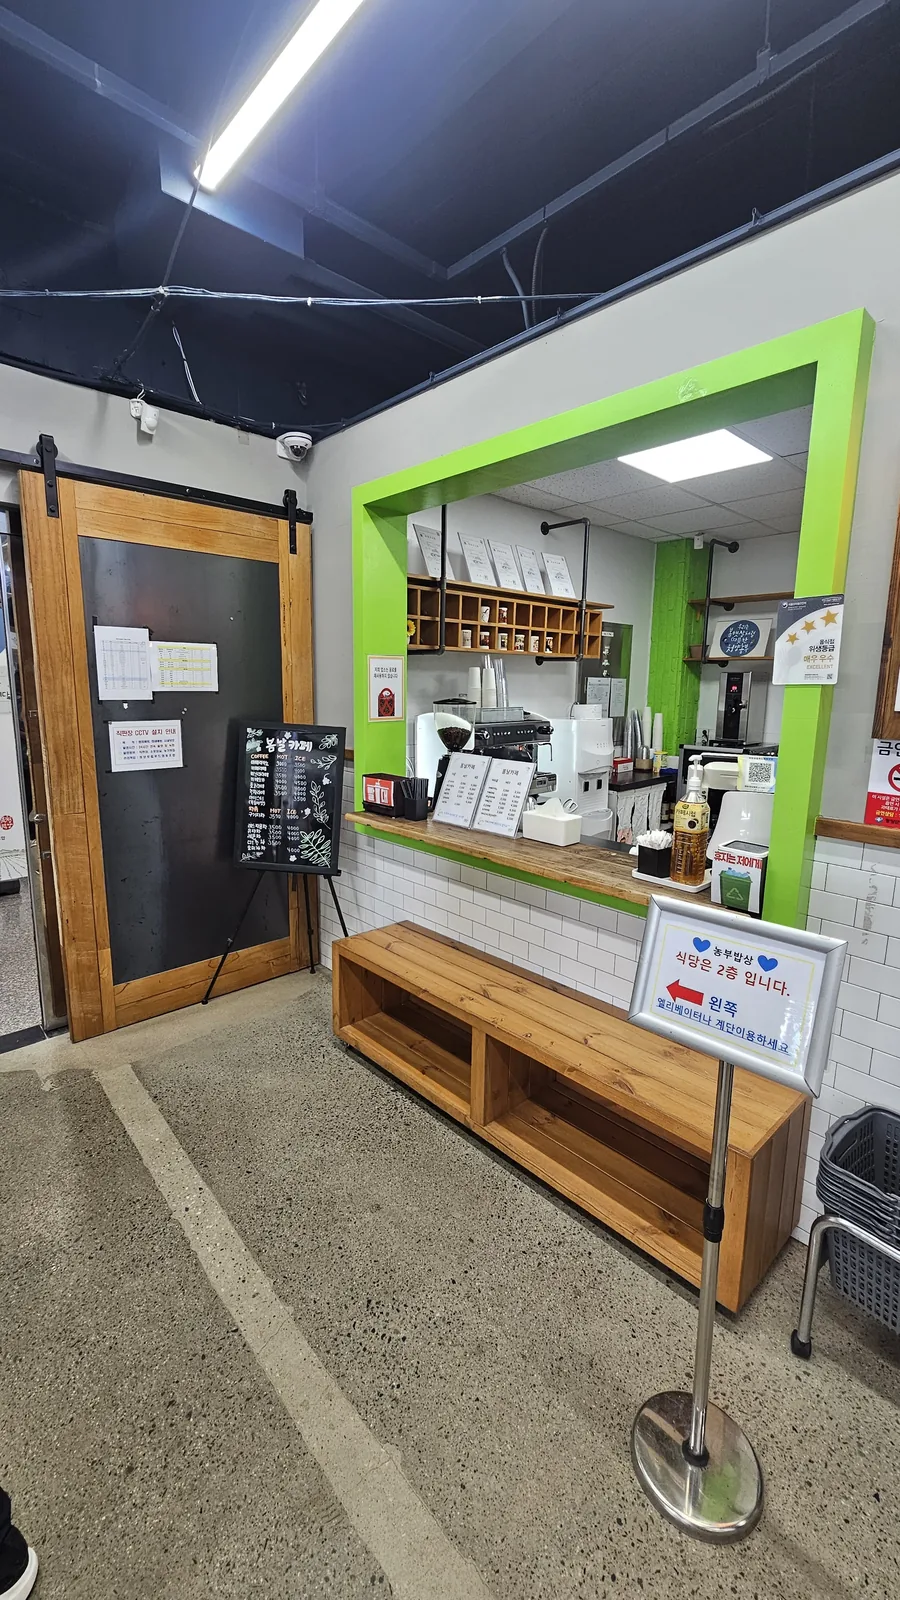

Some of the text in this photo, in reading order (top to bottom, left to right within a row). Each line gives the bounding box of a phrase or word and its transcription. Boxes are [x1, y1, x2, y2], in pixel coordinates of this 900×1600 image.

[804, 655, 818, 663] 매우
[714, 851, 762, 869] 휴지는 저에게
[713, 946, 754, 966] 농부밥상
[676, 951, 790, 997] 식당은 2층 입니다.
[708, 996, 738, 1018] 왼쪽
[657, 998, 789, 1053] 엘리베이터나 계단이용하세요
